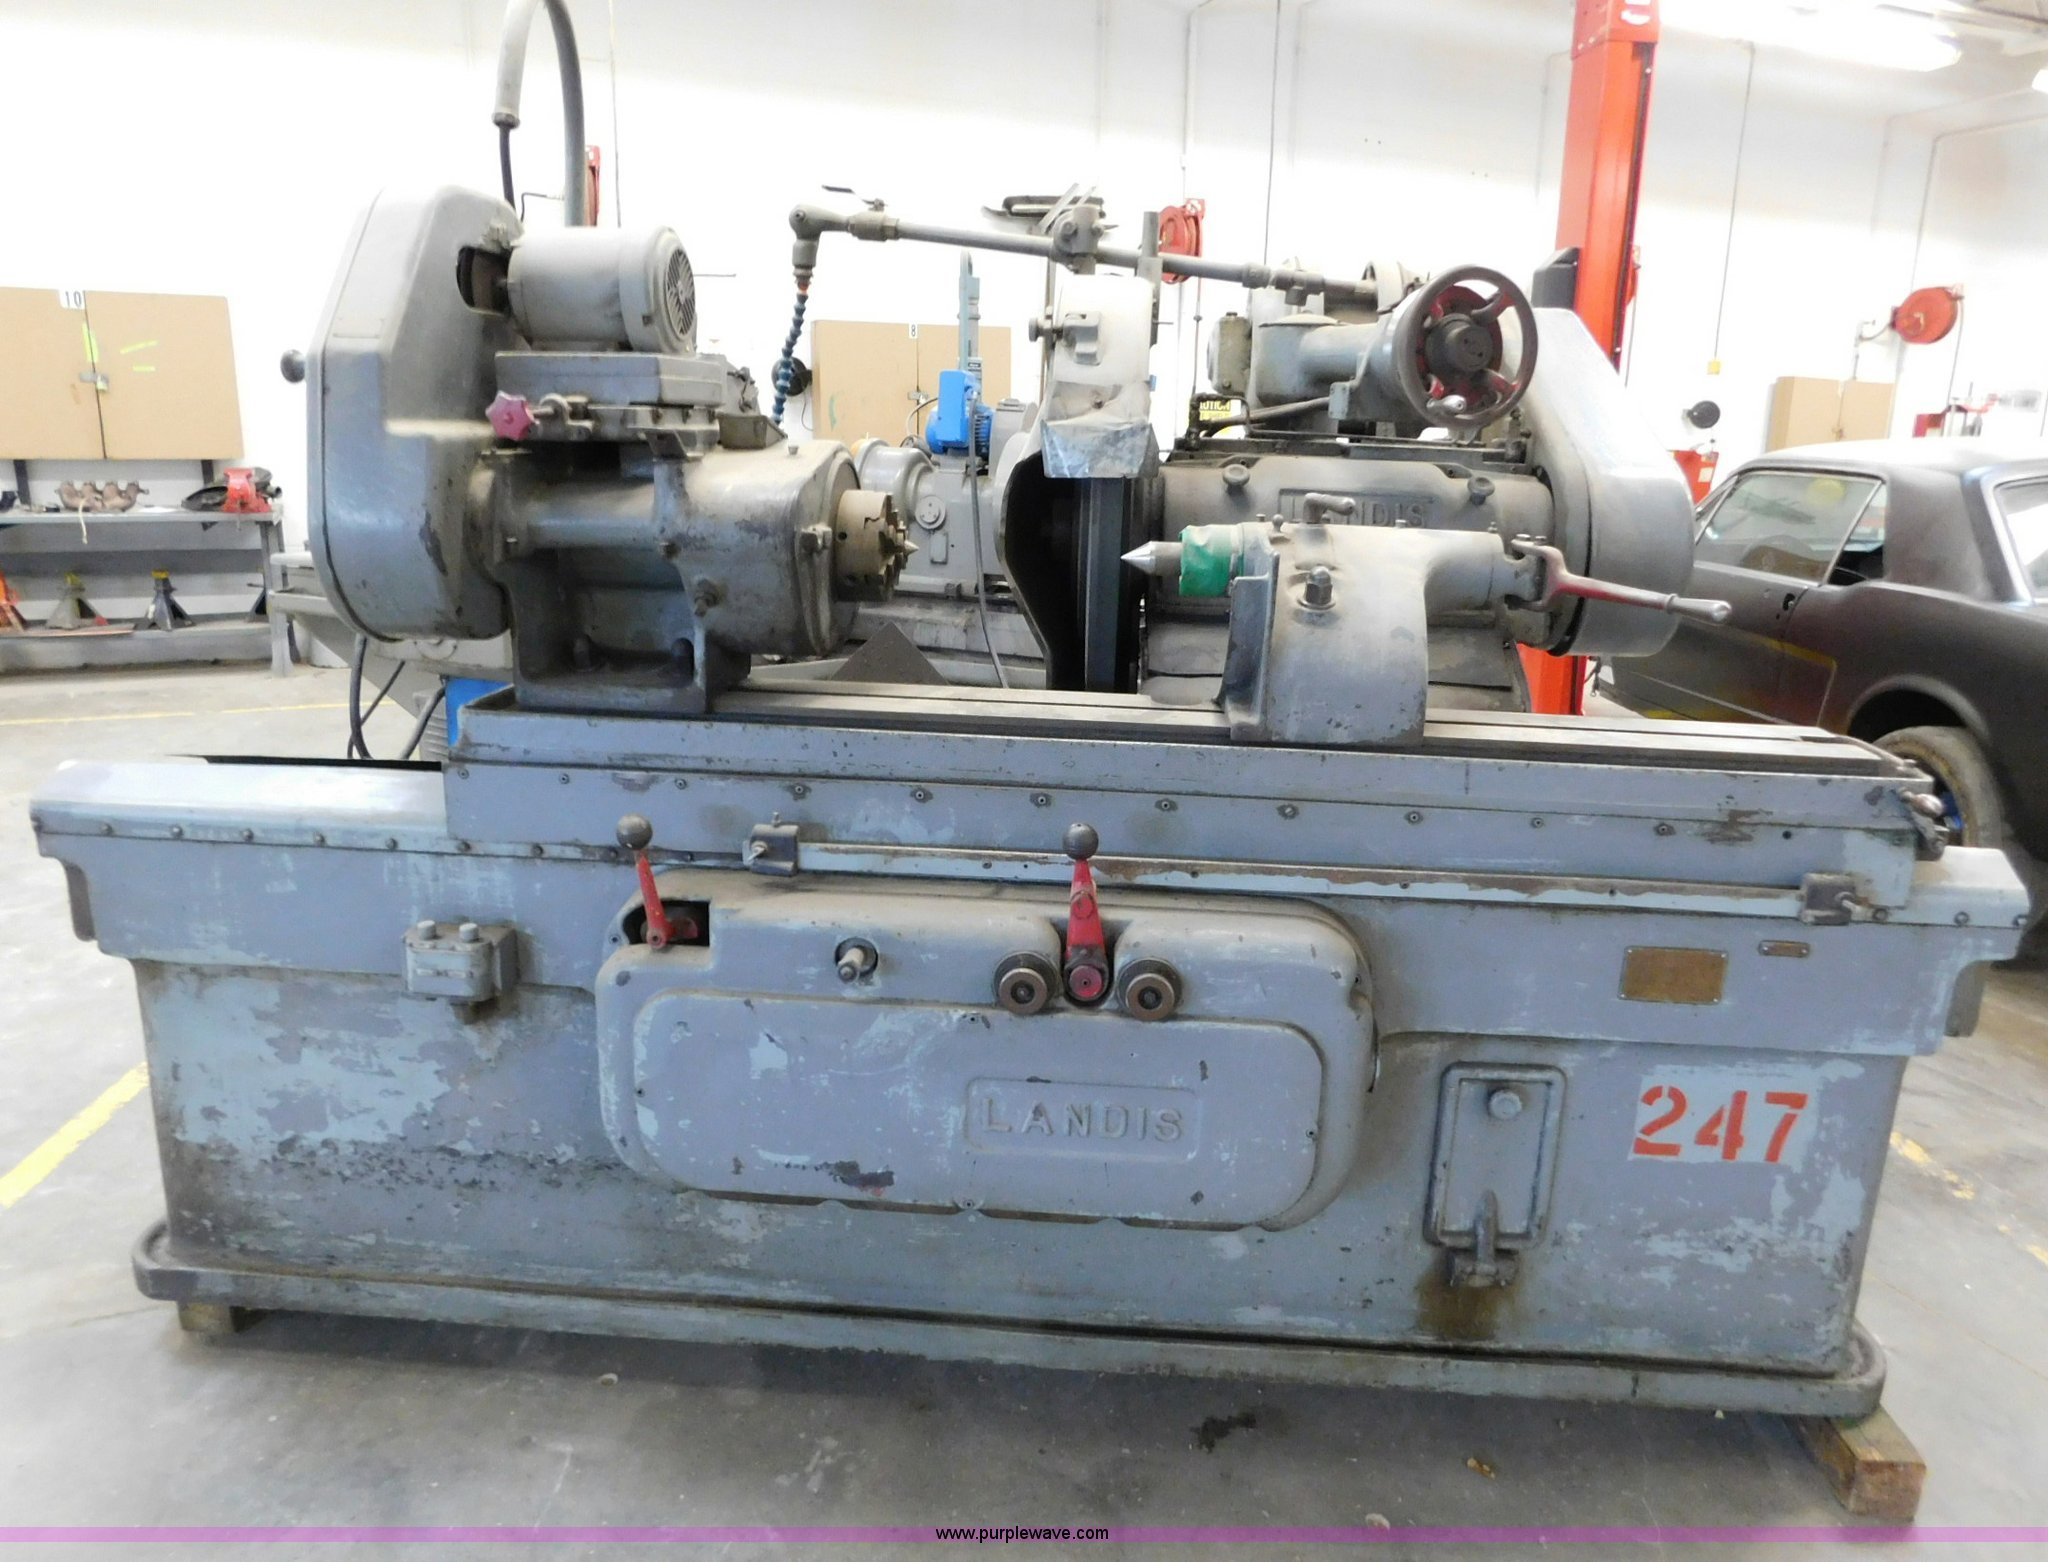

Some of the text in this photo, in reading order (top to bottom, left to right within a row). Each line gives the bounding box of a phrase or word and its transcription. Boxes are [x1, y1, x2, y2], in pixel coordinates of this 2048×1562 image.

[64, 290, 82, 308] 10
[910, 323, 917, 337] 8
[982, 1098, 1184, 1142] LANDIS
[1632, 1085, 1809, 1163] 247
